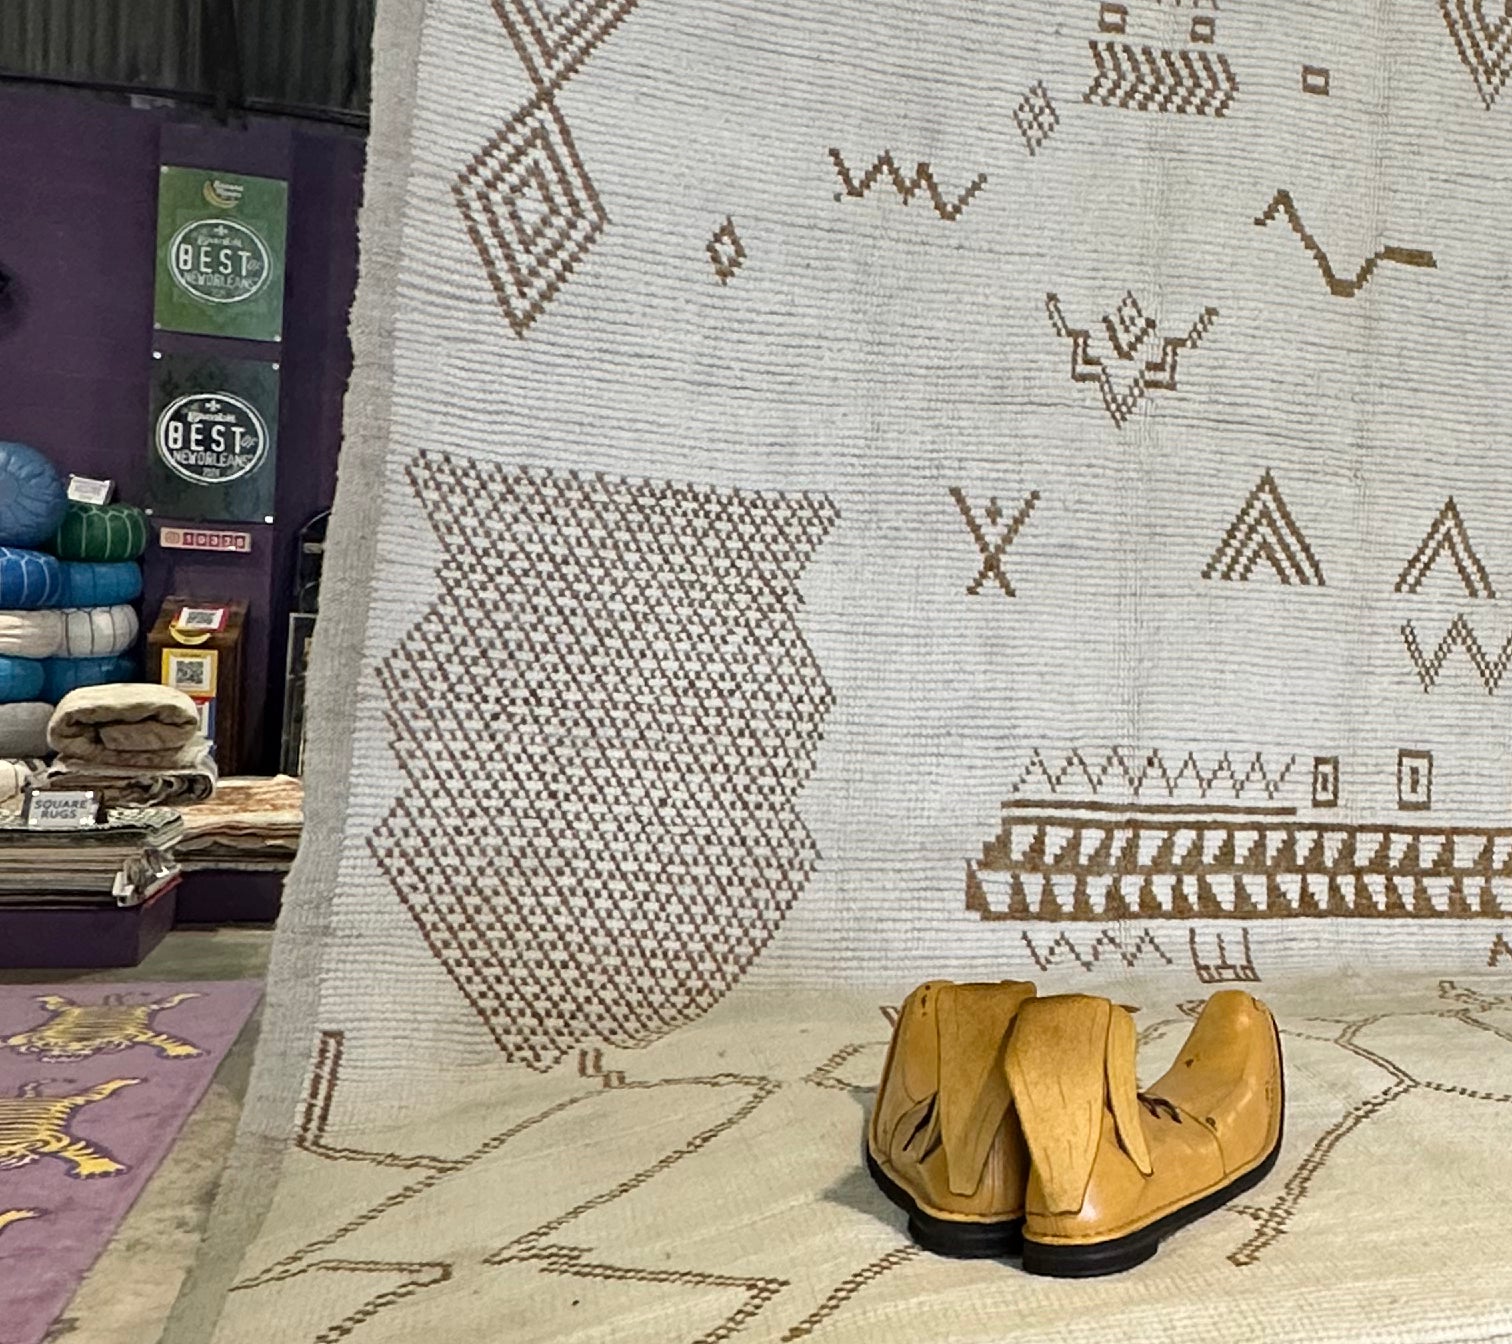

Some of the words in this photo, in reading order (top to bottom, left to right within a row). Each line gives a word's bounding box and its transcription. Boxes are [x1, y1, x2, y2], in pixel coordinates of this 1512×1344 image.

[179, 244, 252, 276] BEST
[168, 420, 246, 454] BEST
[34, 799, 87, 809] SQUARE
[40, 809, 77, 819] RUGS
